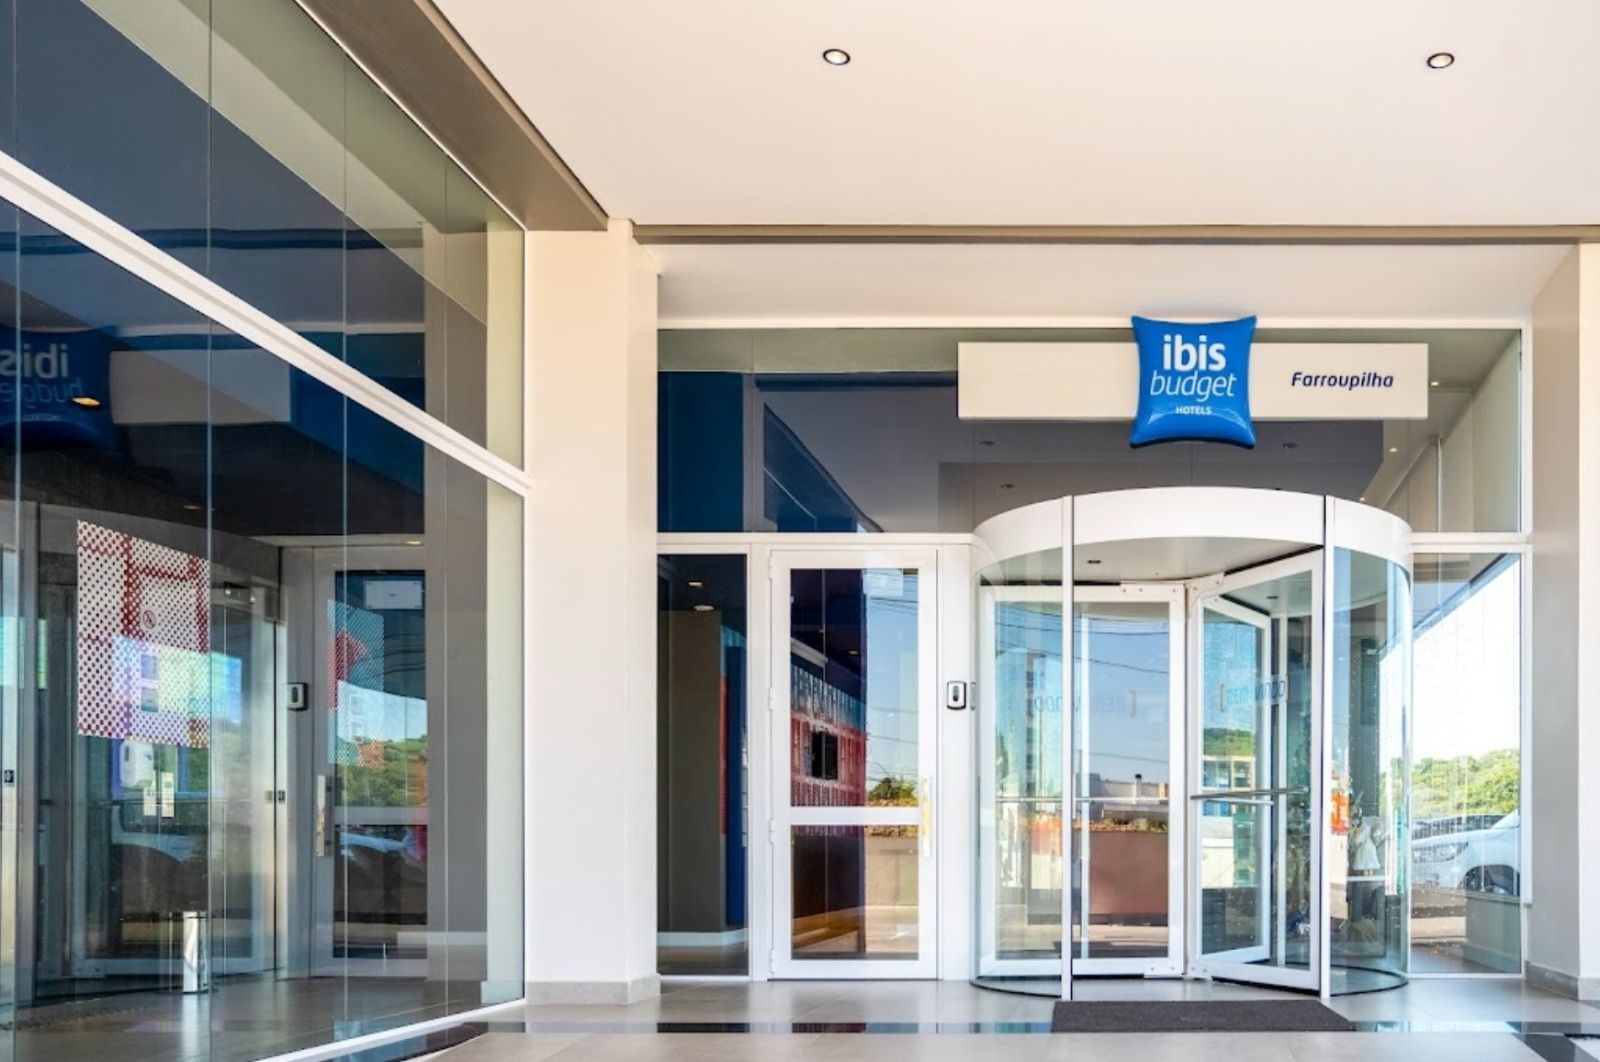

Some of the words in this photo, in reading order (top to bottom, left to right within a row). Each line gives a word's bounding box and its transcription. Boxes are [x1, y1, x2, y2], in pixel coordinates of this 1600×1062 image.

[1163, 334, 1226, 371] ibis
[1150, 369, 1237, 402] budget
[1290, 371, 1394, 391] Farroupilha
[1176, 406, 1212, 415] HOTELS
